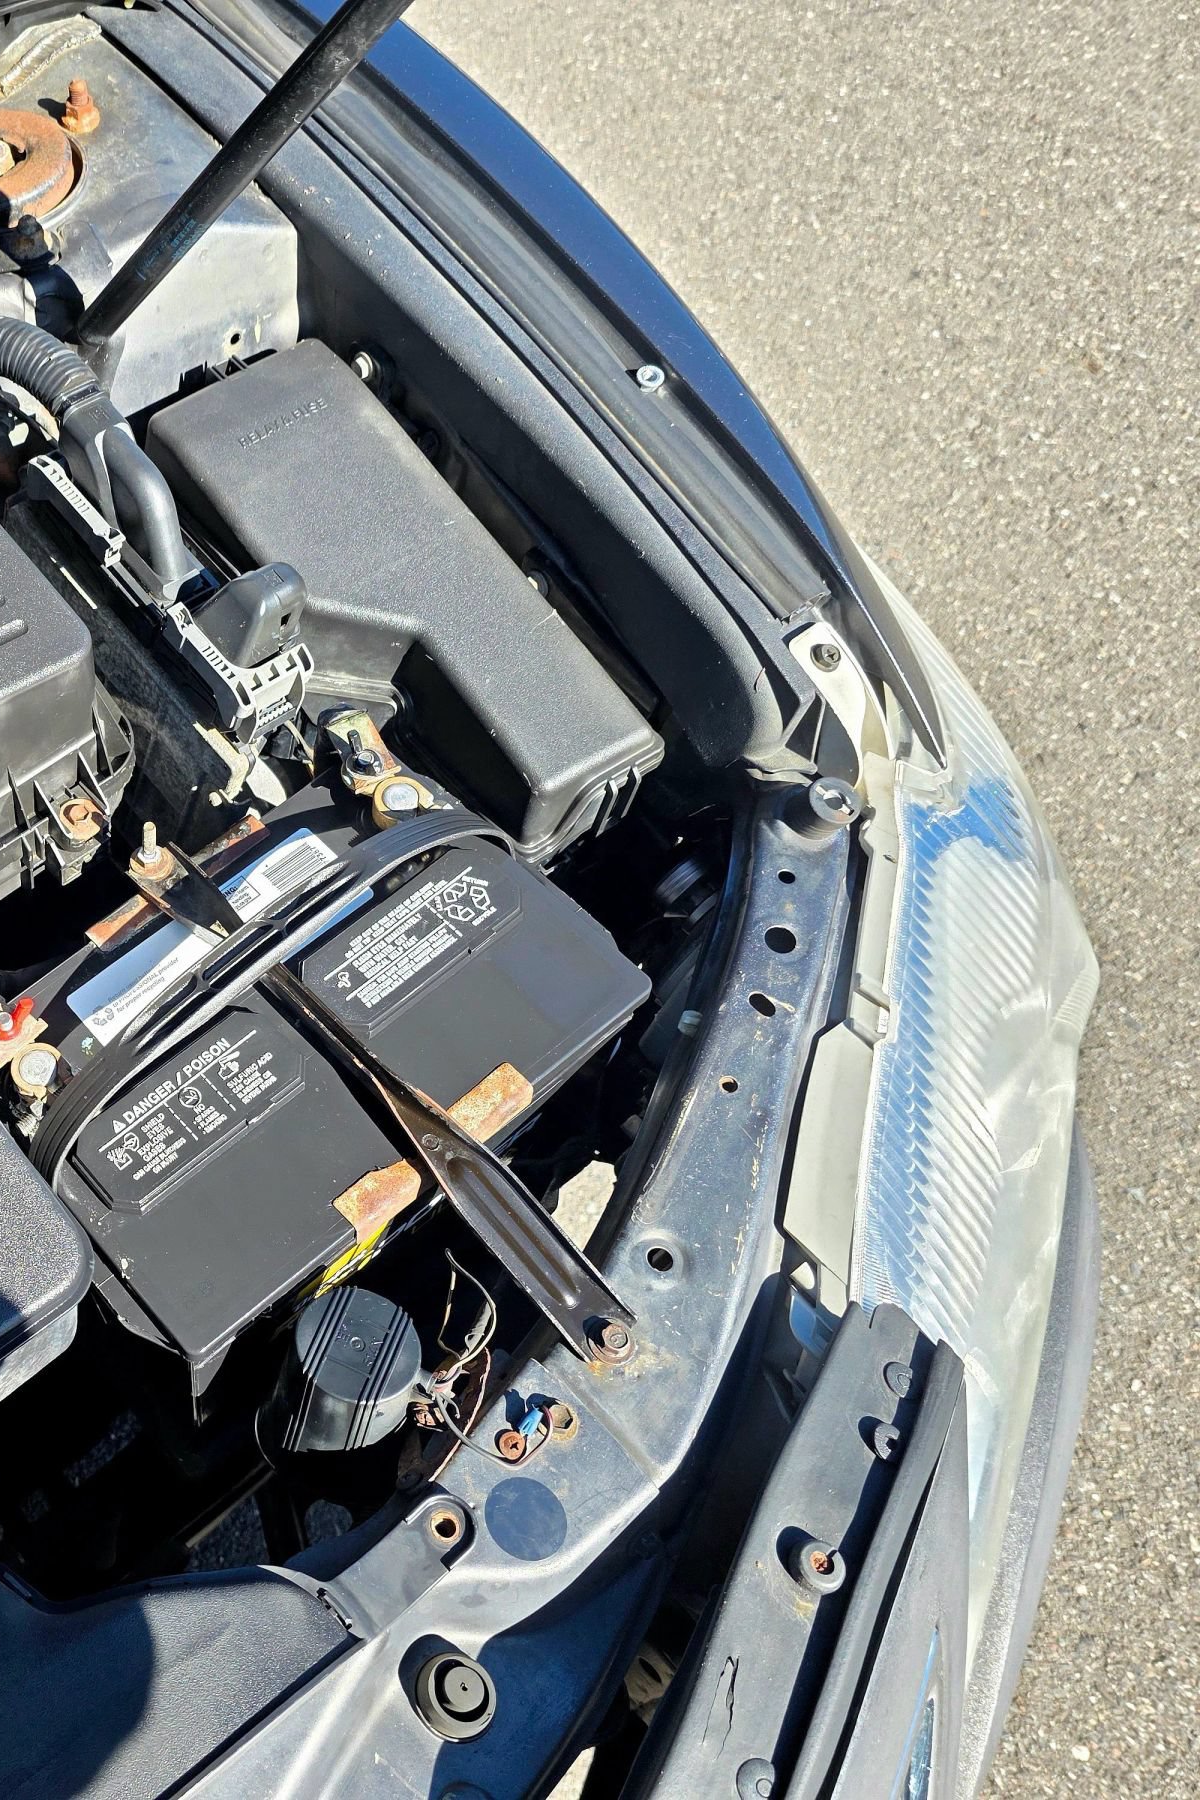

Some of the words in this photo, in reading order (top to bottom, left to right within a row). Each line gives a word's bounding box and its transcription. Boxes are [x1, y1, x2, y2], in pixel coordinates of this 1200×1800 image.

[237, 419, 281, 450] RELAY
[290, 397, 328, 422] FUSE
[121, 1080, 176, 1122] DANGER
[181, 1038, 231, 1076] POISON
[226, 1063, 259, 1089] SULFURIC
[255, 1052, 274, 1066] ACID
[231, 1083, 245, 1094] CAN
[192, 1103, 206, 1114] NO
[140, 1113, 166, 1133] SHIELD
[146, 1123, 166, 1138] EYES
[136, 1127, 174, 1155] EXPLOSIVE
[142, 1142, 167, 1162] GASES
